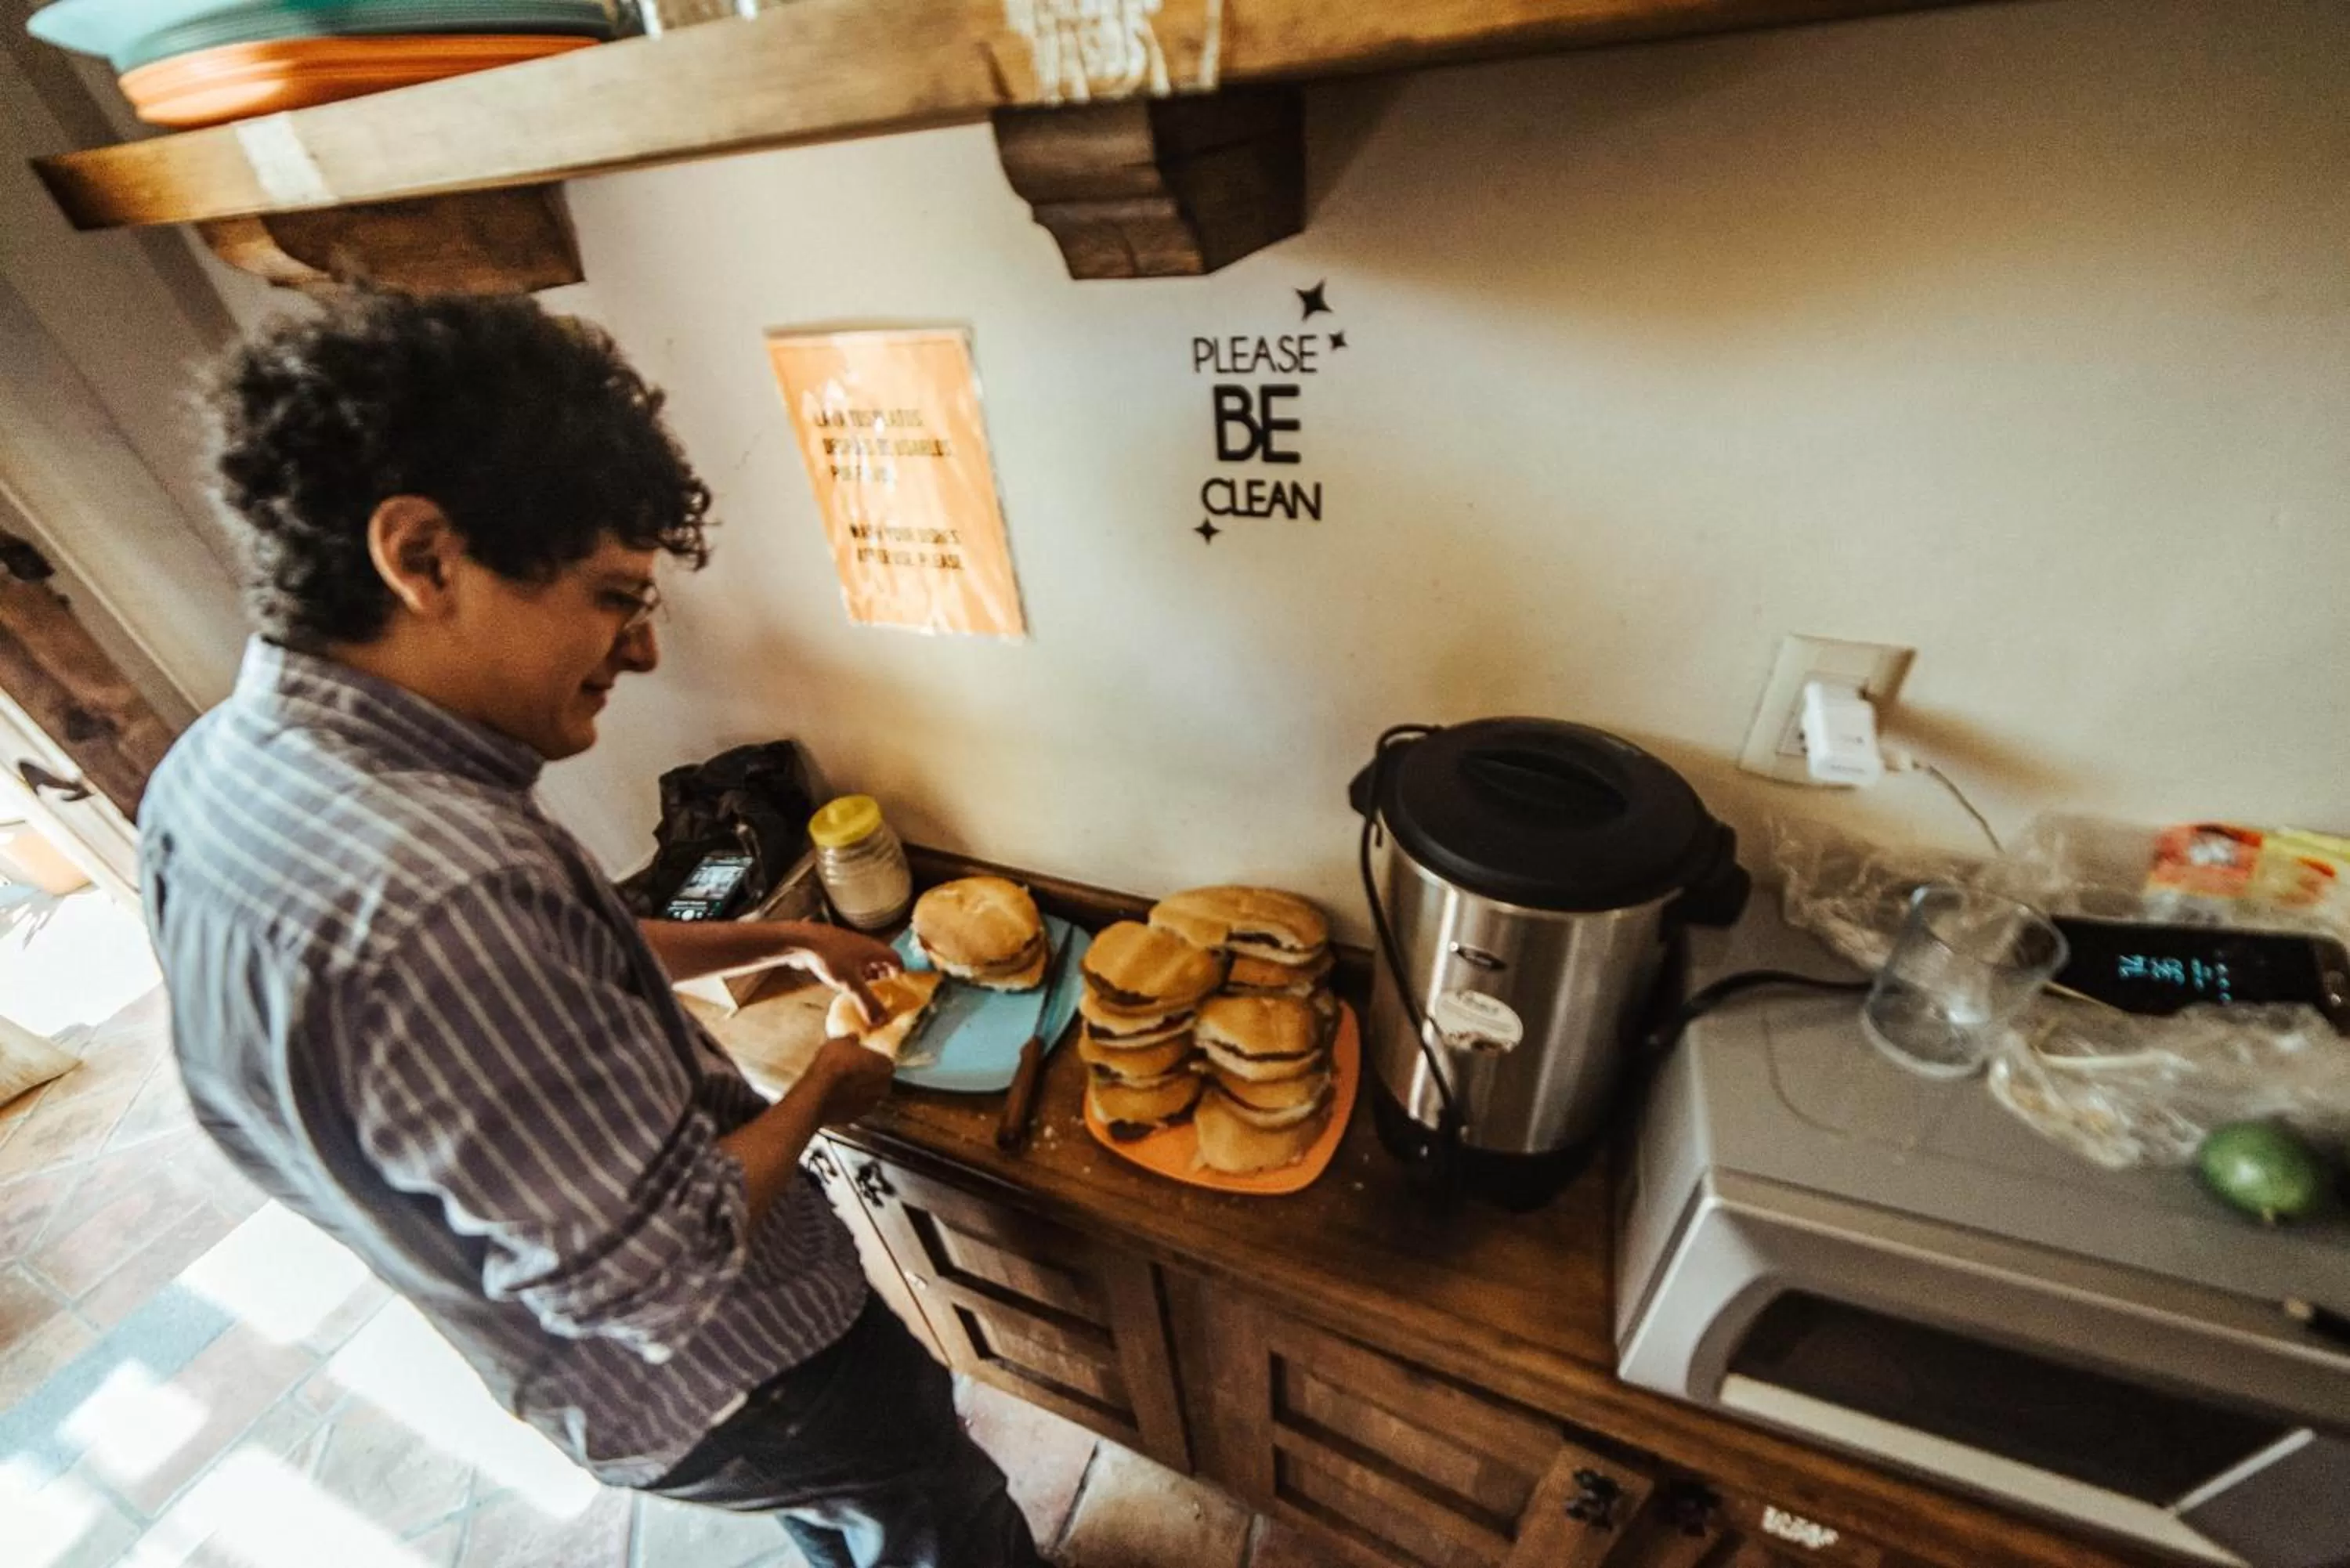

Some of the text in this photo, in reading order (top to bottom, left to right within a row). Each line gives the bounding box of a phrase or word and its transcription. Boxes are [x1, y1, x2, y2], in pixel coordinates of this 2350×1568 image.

[1193, 334, 1318, 374] PLEASE
[1213, 384, 1301, 464] BE
[1201, 477, 1322, 521] CLEAN
